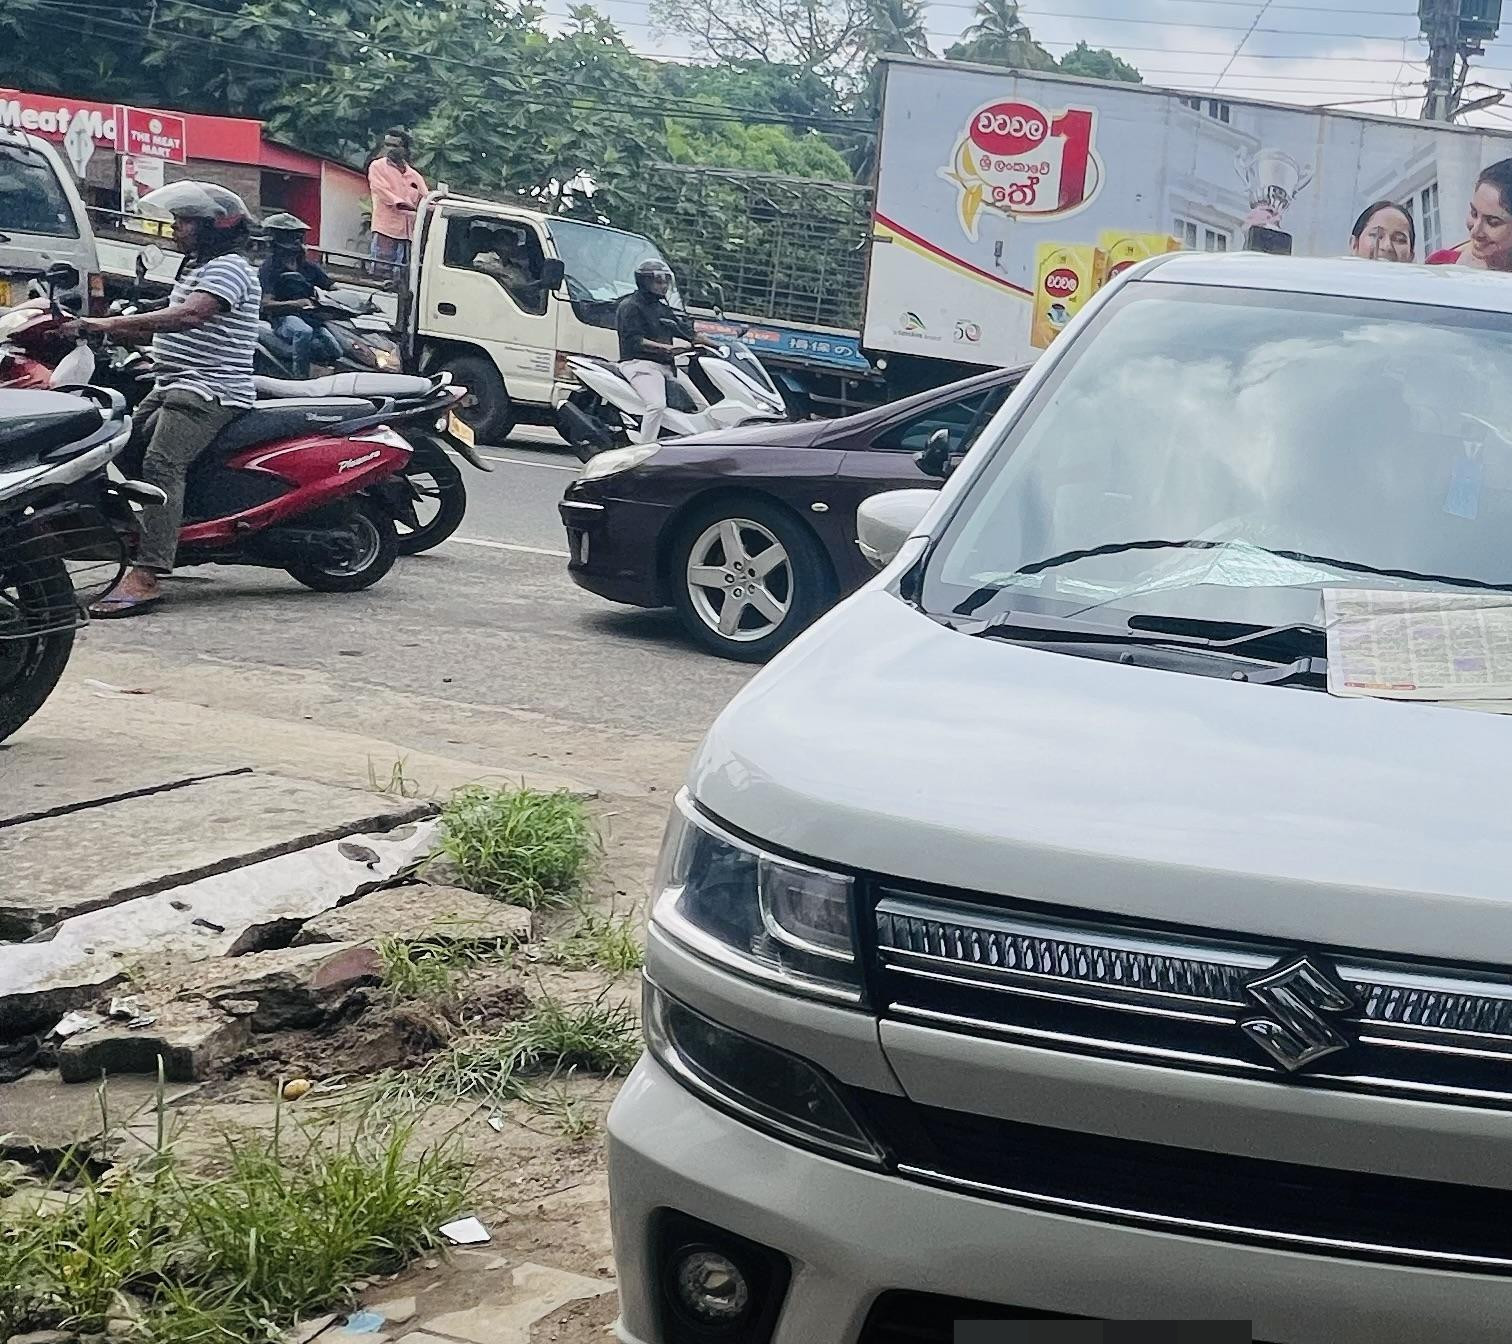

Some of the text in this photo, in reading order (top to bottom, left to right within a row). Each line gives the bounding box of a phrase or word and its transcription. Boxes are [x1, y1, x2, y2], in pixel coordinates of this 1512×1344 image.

[0, 99, 72, 134] Meat
[131, 130, 181, 149] THE MEAT
[140, 143, 171, 158] MART
[1051, 109, 1093, 210] 1
